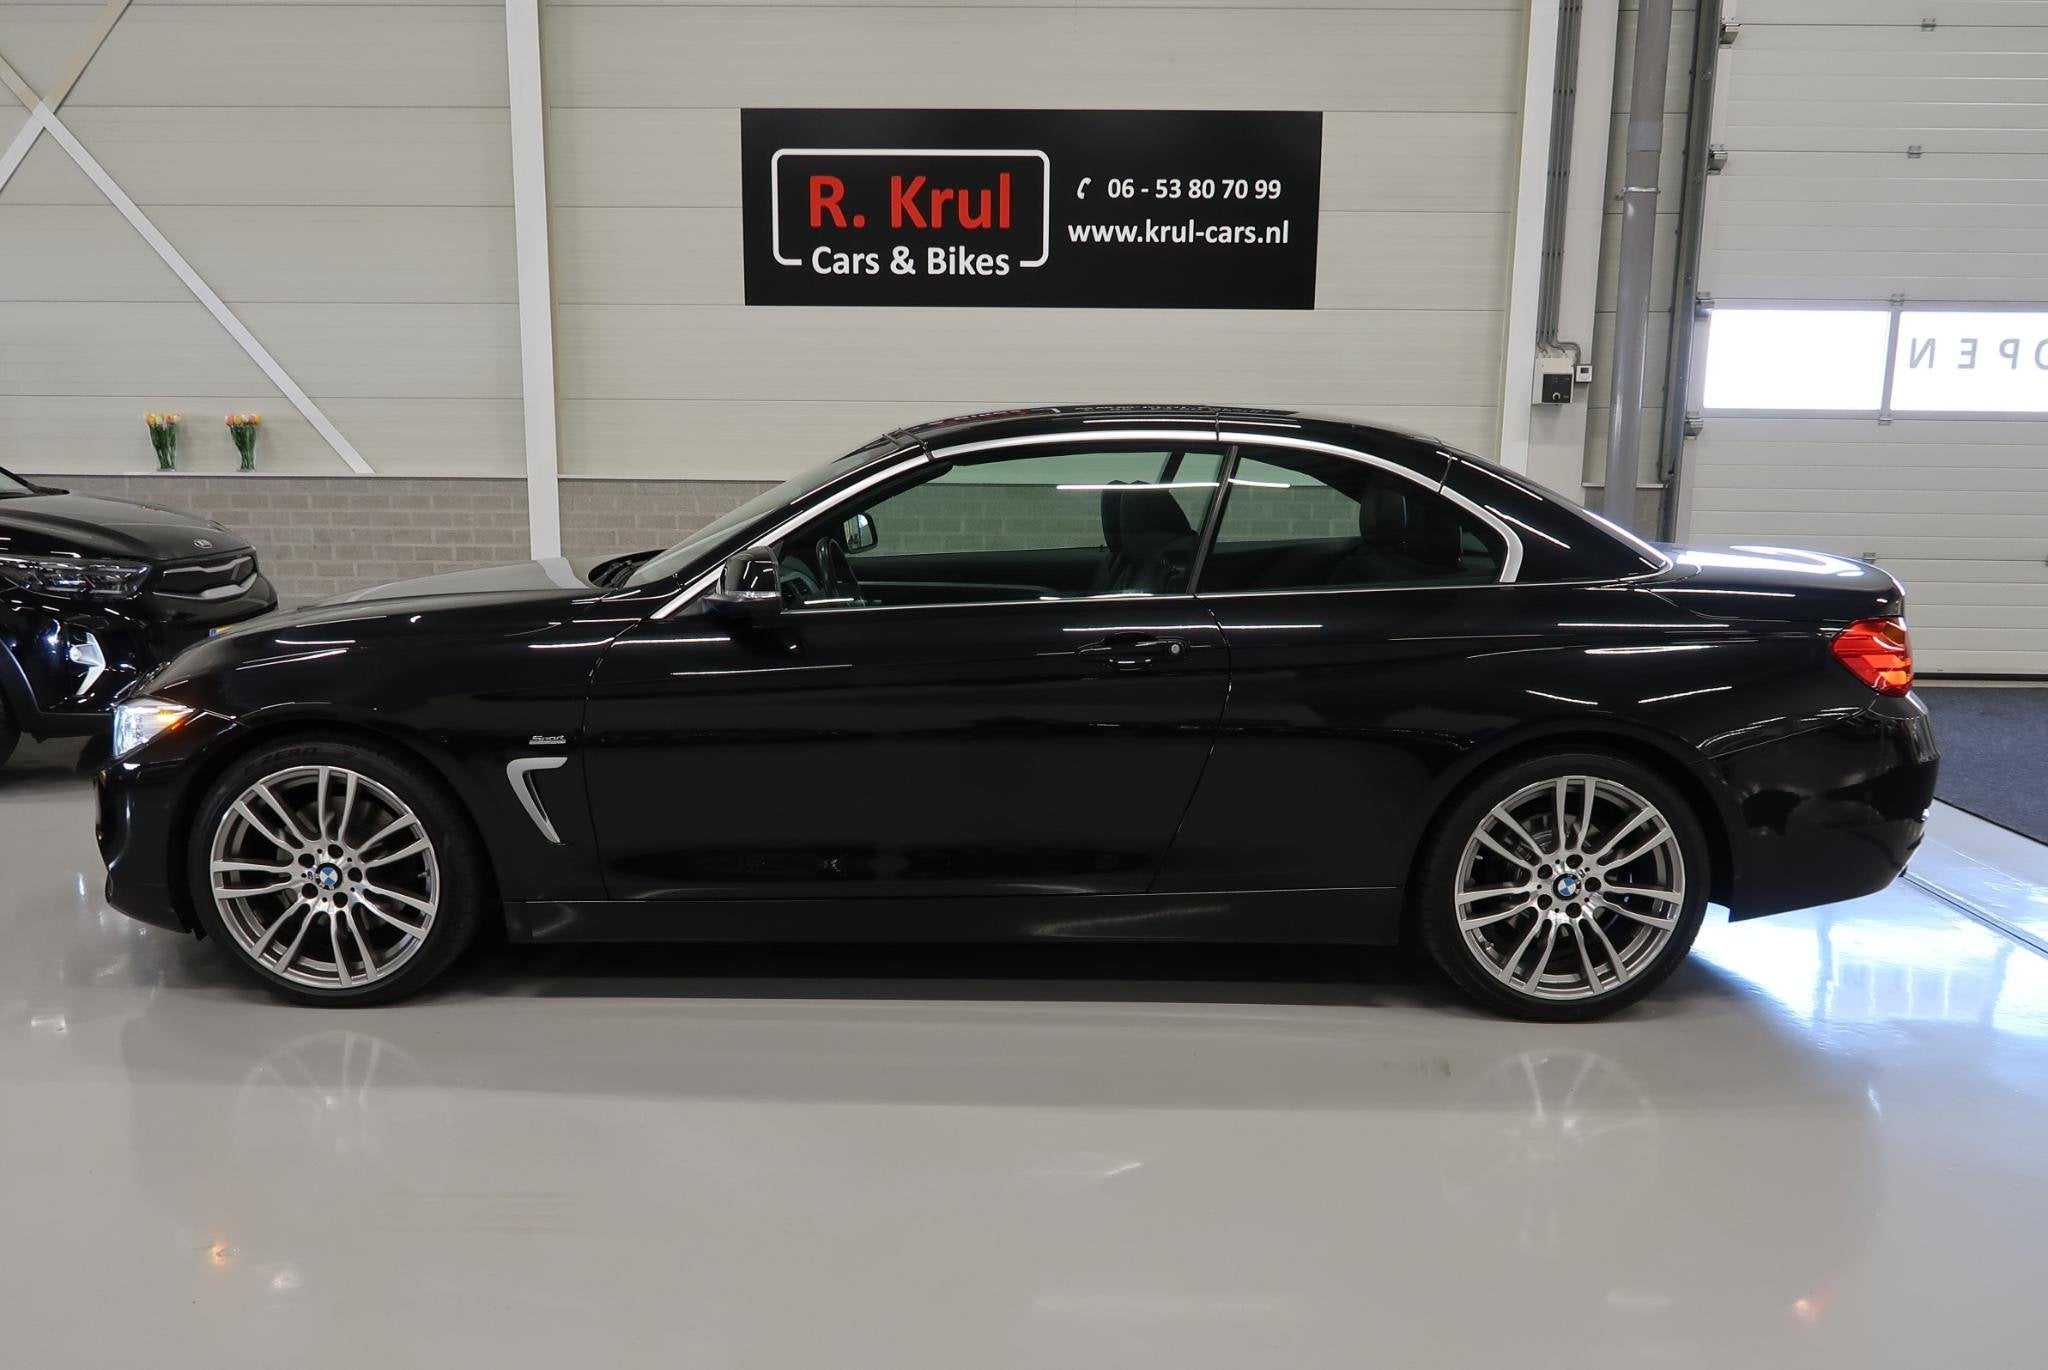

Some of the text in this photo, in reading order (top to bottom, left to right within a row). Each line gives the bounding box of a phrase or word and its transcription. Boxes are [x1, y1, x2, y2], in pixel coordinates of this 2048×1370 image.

[810, 172, 1011, 229] R. Krul
[1107, 178, 1135, 199] 06
[1155, 178, 1182, 199] 53
[1188, 178, 1216, 199] 80
[1221, 179, 1249, 200] 70
[1254, 179, 1282, 200] 99
[1068, 218, 1289, 245] www.krul-cars.nl
[811, 246, 1010, 275] Cars & Bikes
